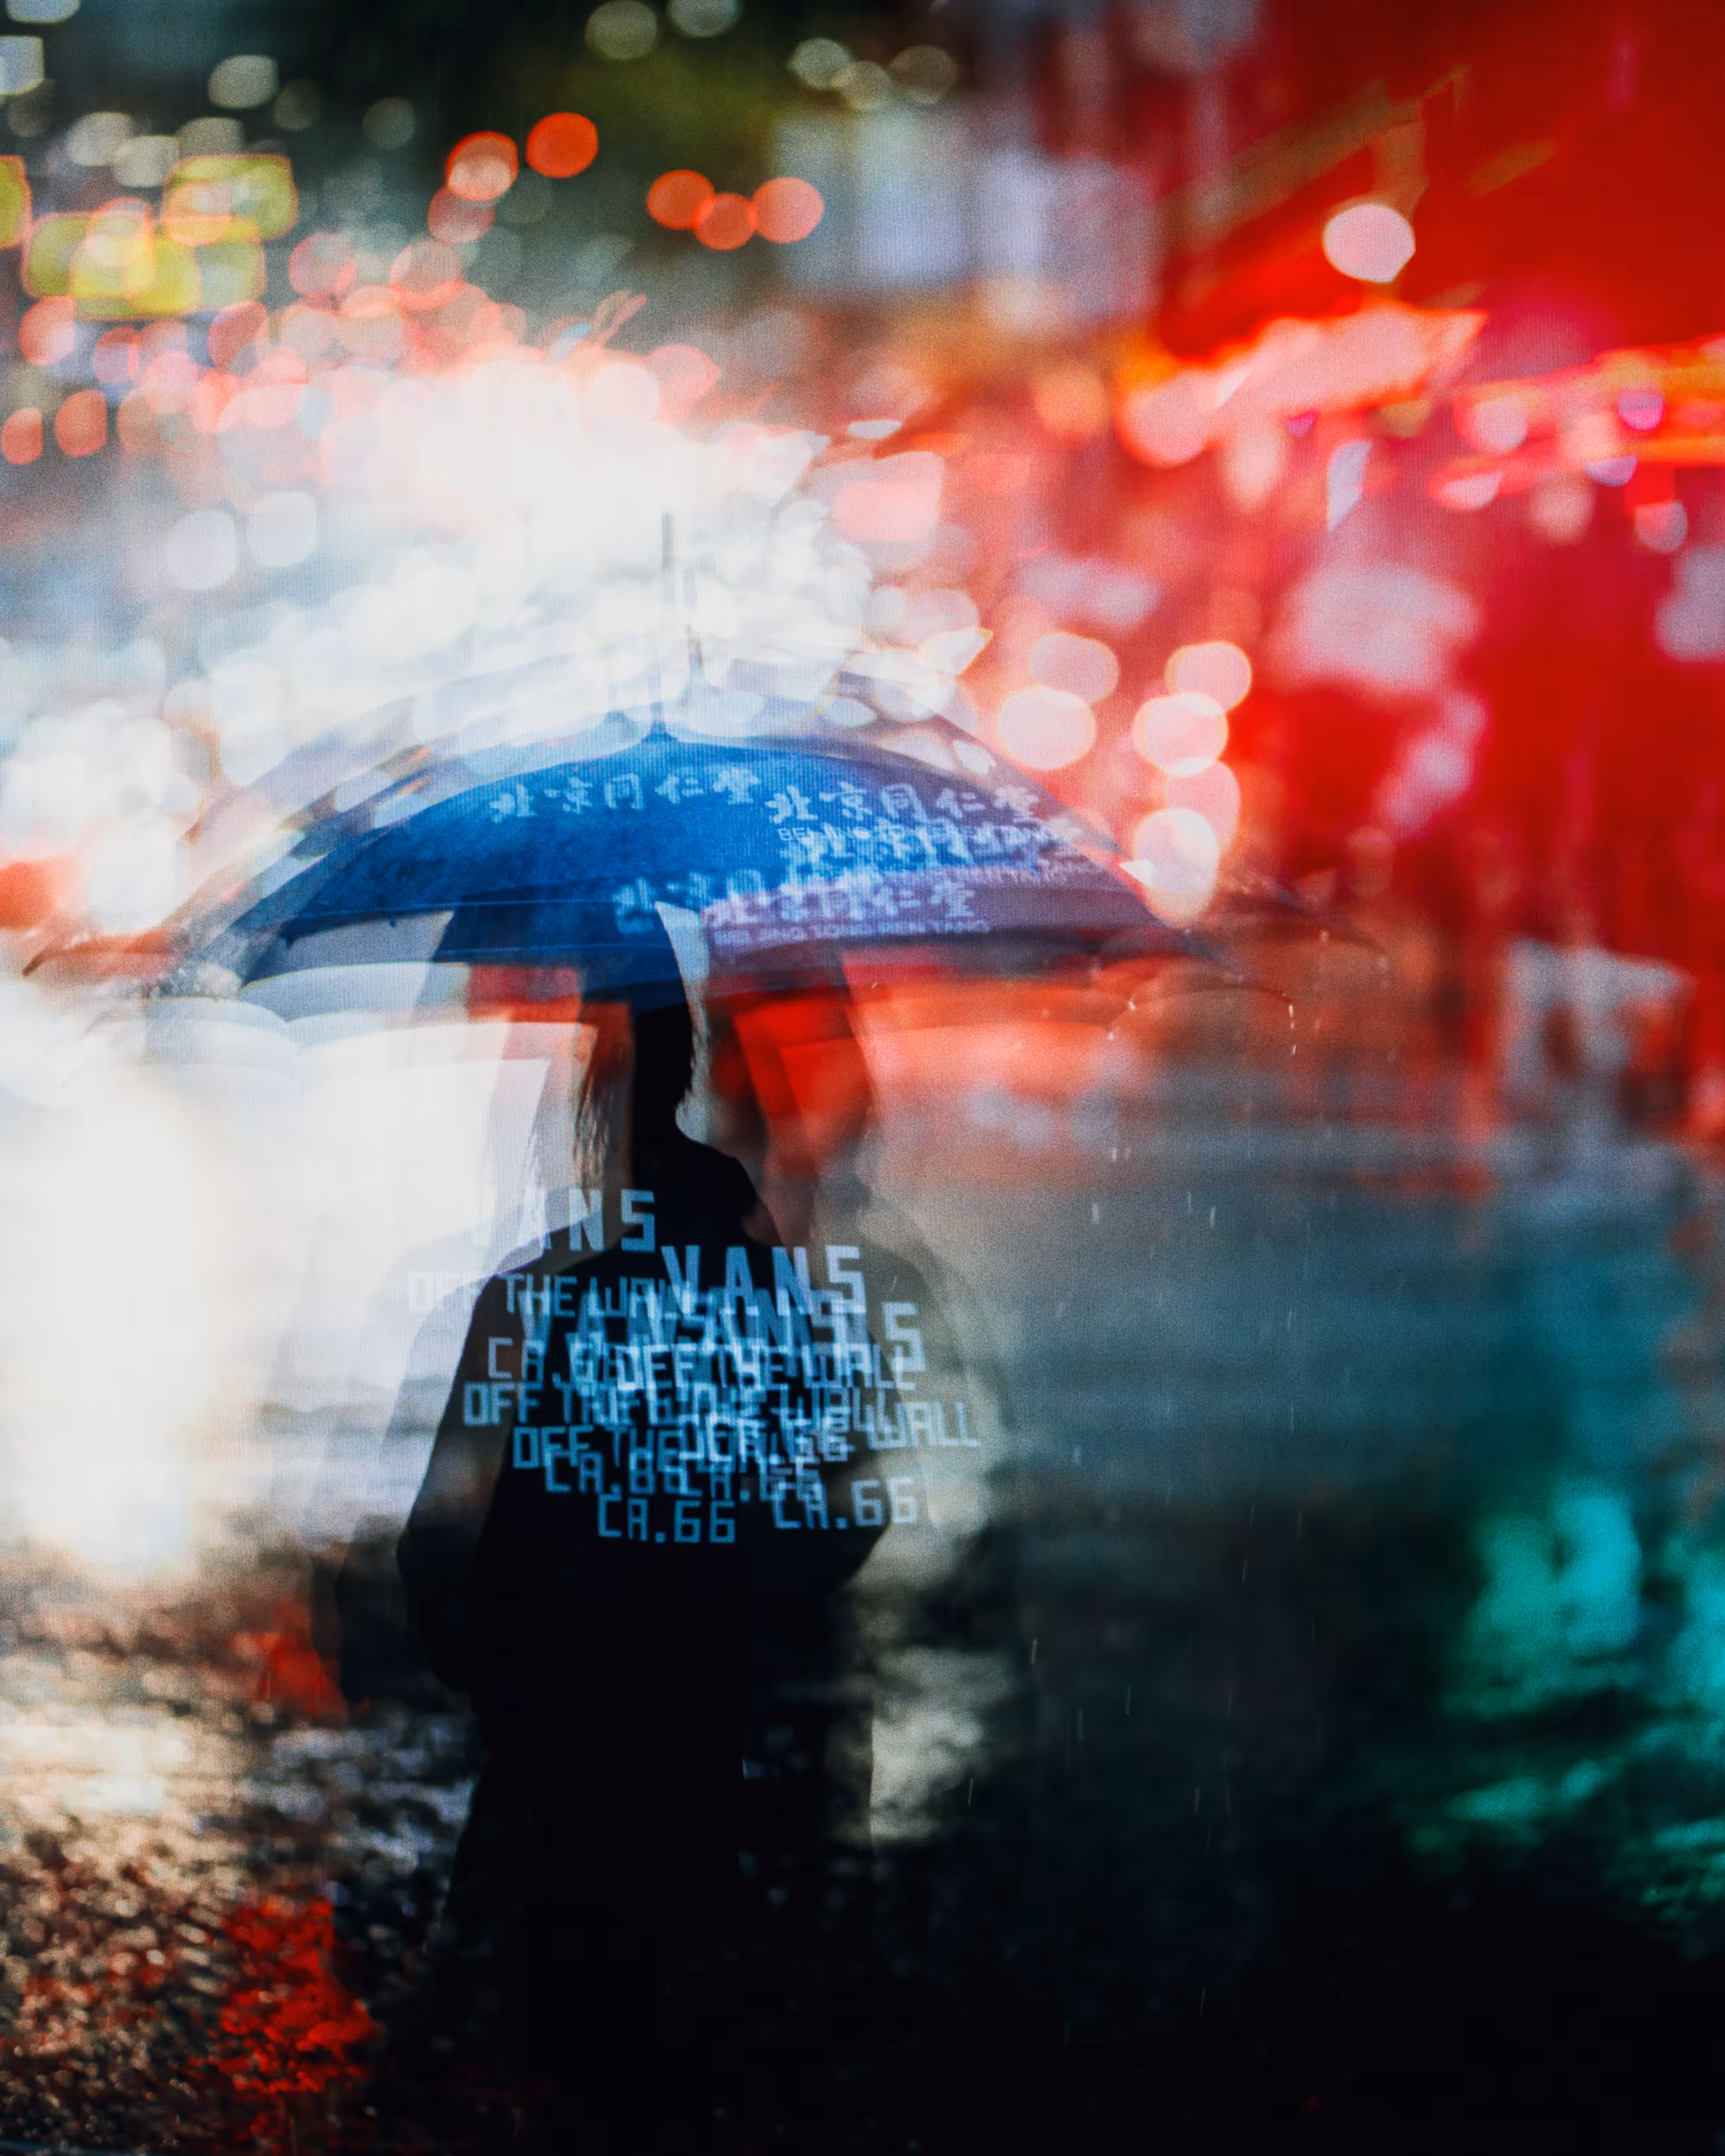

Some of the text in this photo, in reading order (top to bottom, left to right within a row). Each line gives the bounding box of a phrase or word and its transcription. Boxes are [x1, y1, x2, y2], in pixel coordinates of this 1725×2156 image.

[499, 1273, 577, 1317] THE
[661, 1244, 866, 1315] VANS
[464, 1382, 543, 1426] OFF
[864, 1401, 979, 1450] WALL
[513, 1424, 594, 1469] OFF
[598, 1494, 735, 1544] CA.66
[775, 1473, 919, 1529] CA.66
